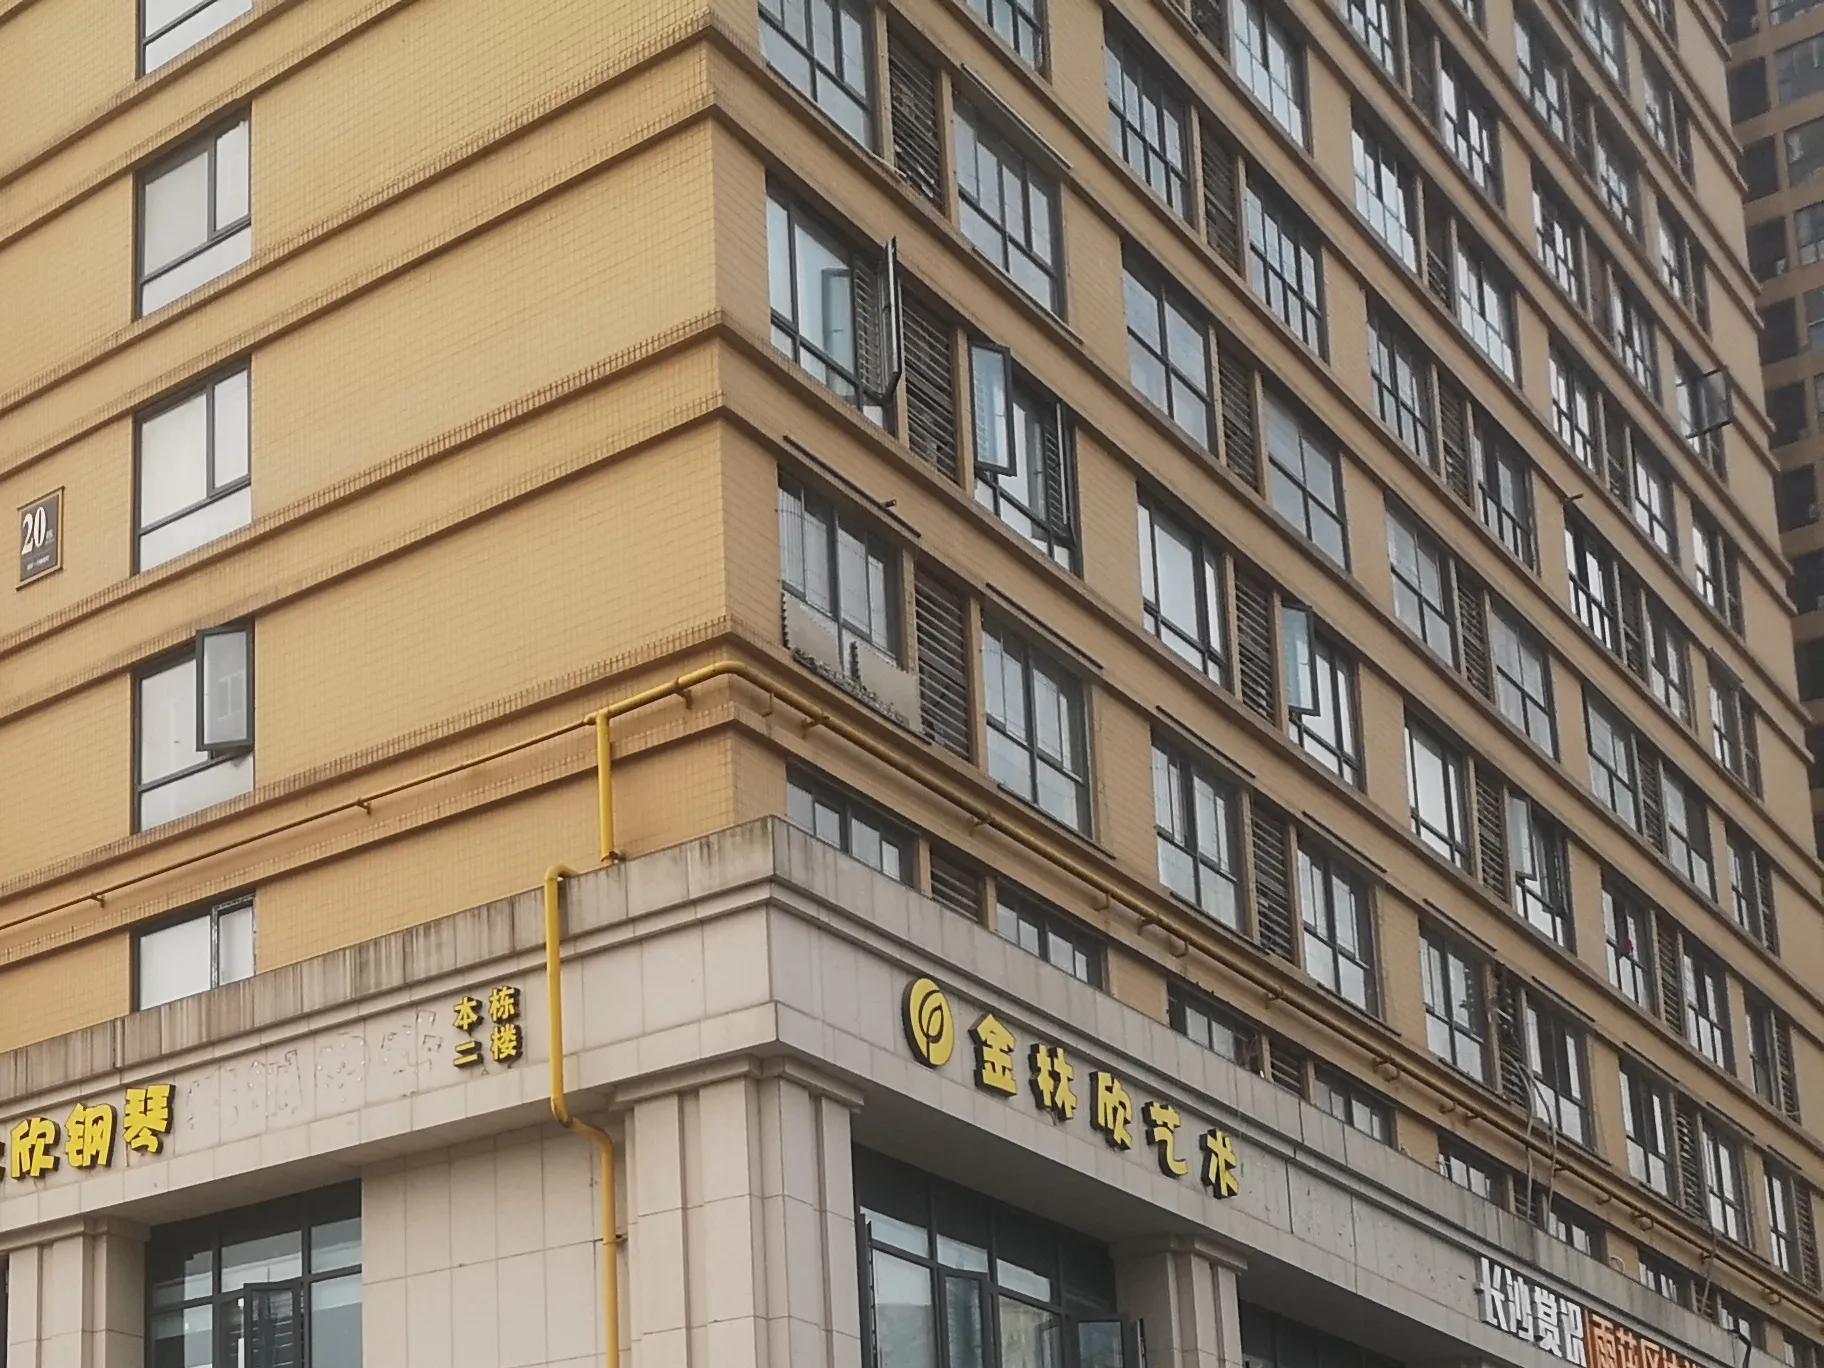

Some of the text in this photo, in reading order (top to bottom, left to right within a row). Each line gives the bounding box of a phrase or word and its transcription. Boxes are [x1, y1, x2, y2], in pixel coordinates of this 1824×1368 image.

[20, 506, 47, 555] 20
[969, 1013, 1240, 1199] 金林欣艺术
[1479, 1256, 1588, 1368] 长沙赏识
